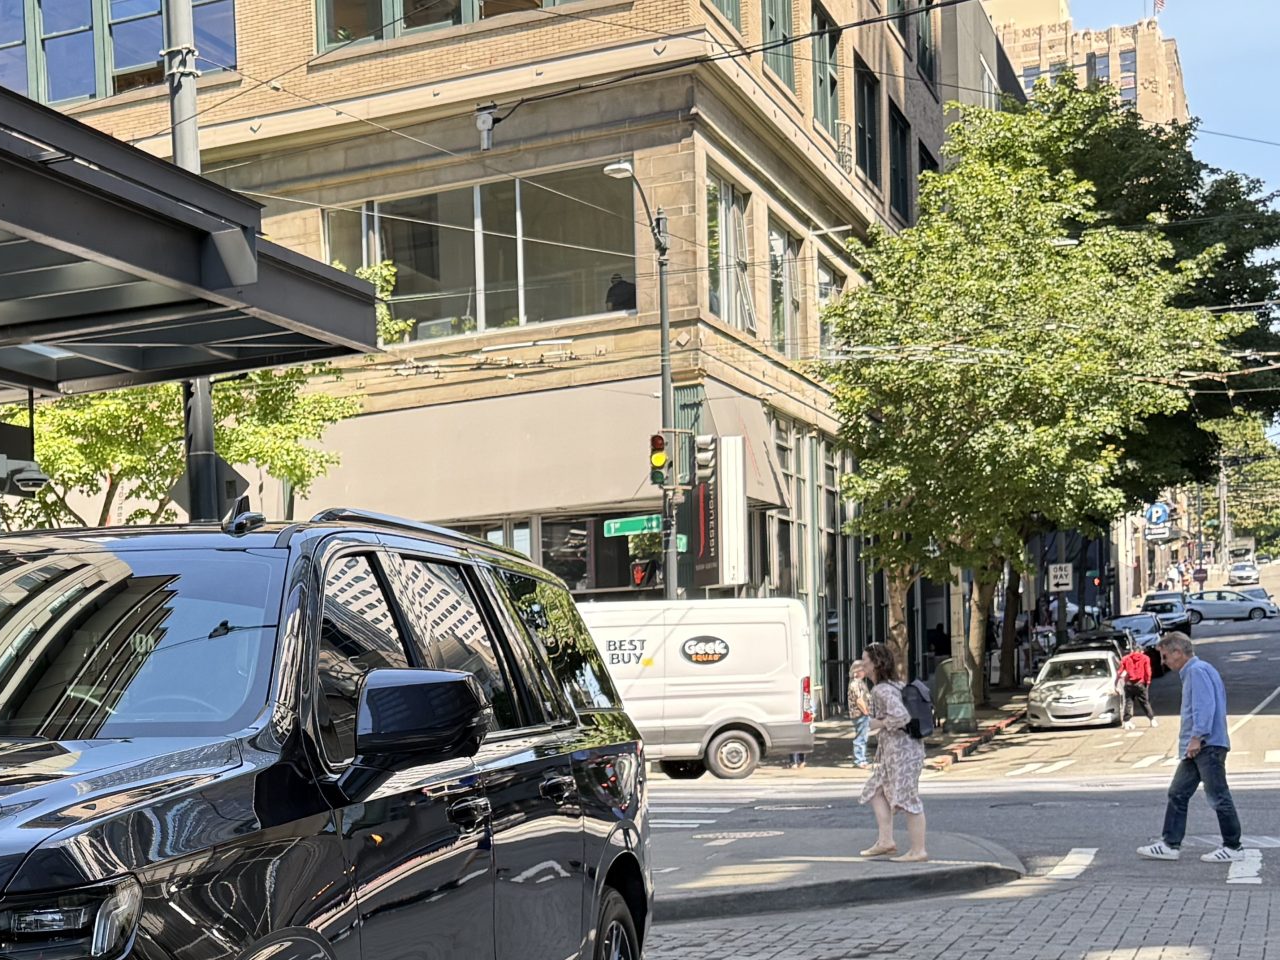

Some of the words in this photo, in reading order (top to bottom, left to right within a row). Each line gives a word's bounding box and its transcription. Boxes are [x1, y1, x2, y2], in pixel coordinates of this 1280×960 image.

[1151, 507, 1163, 523] P
[1052, 565, 1069, 573] ONE
[1053, 573, 1069, 581] WAY
[606, 639, 647, 652] BEST
[684, 640, 727, 655] Geek
[609, 652, 644, 665] BUY
